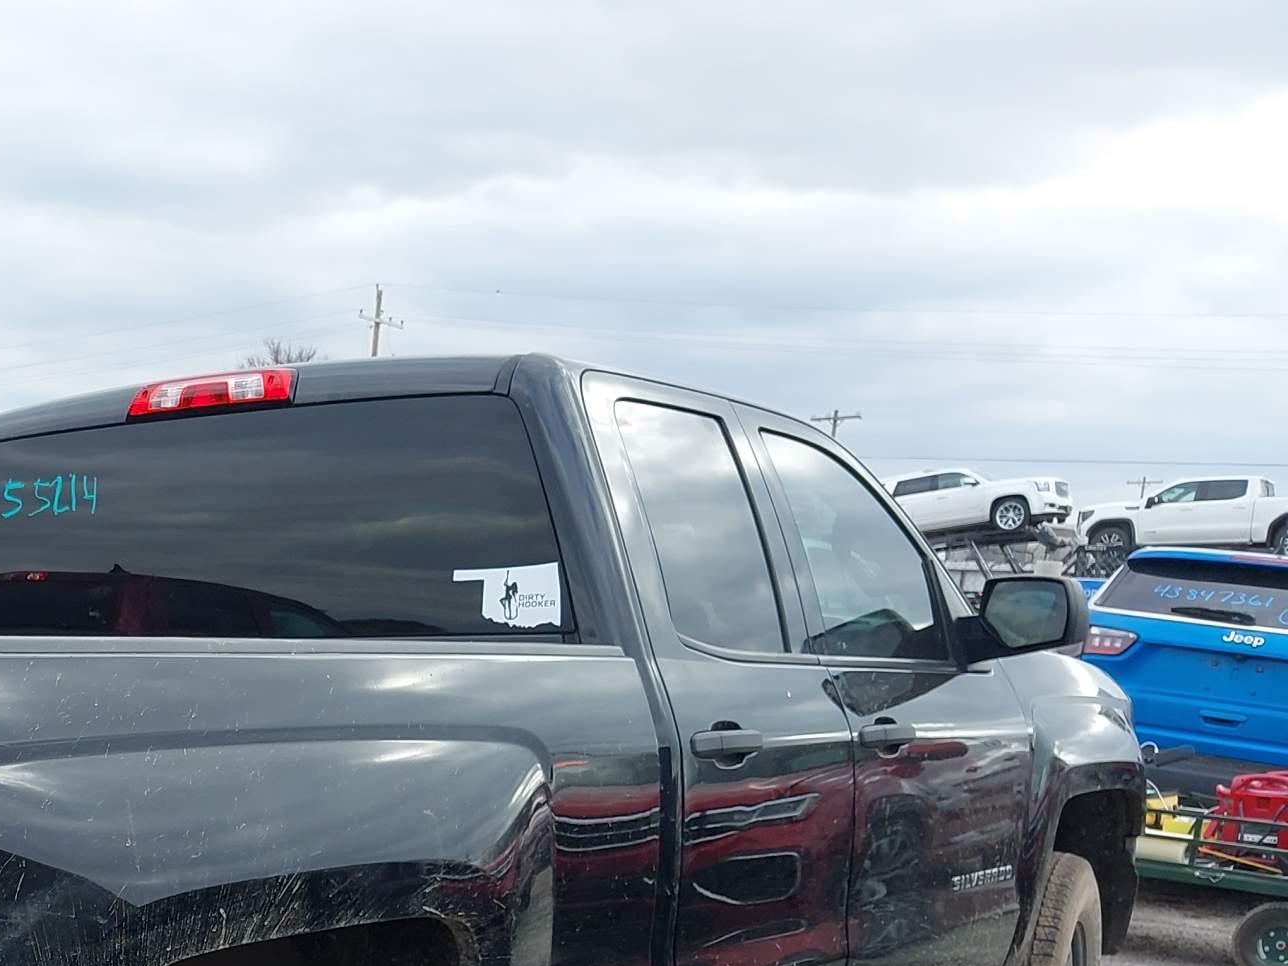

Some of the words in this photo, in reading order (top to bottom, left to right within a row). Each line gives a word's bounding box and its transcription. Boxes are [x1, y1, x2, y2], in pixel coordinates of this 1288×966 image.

[518, 593, 546, 601] DIRTY
[518, 600, 556, 608] HOOKER
[1222, 631, 1265, 648] Jeep
[952, 864, 1014, 891] SILVERADO
